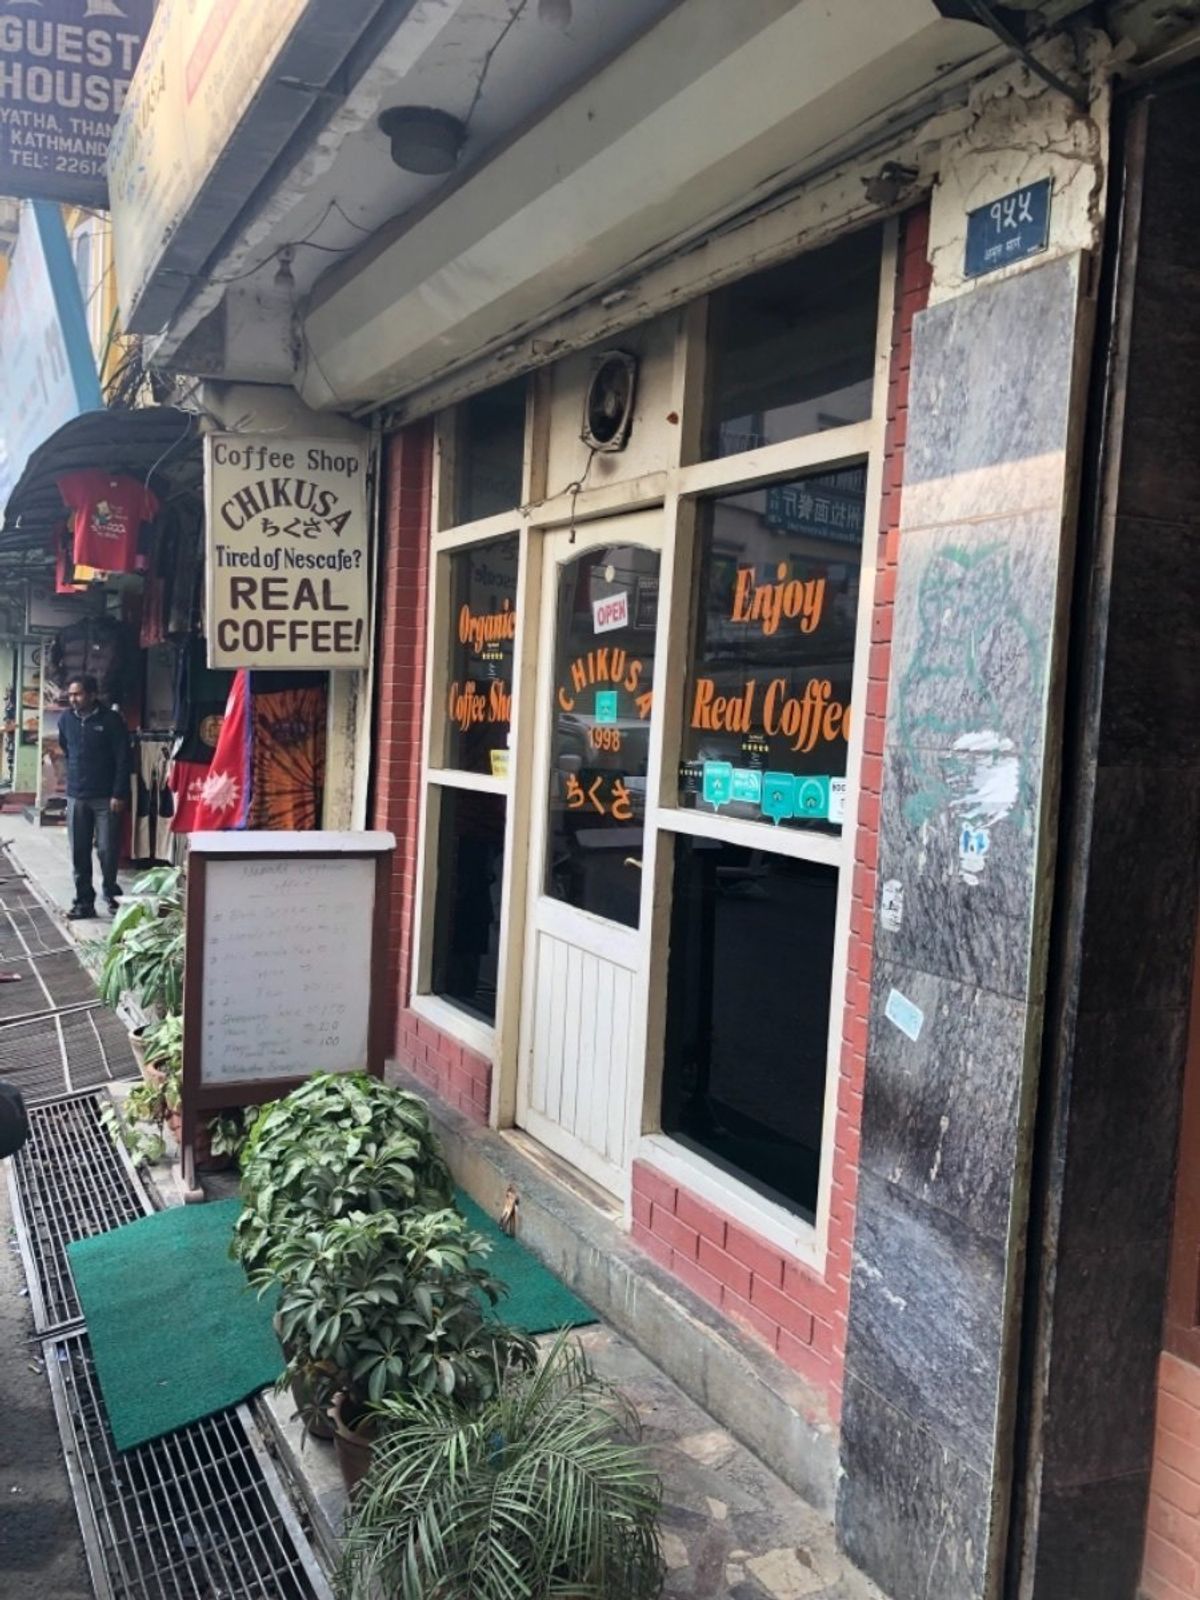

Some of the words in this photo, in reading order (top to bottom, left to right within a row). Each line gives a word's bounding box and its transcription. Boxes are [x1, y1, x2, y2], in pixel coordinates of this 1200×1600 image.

[0, 14, 140, 71] GUEST
[9, 149, 49, 169] TEL:
[214, 443, 295, 471] Coffee
[308, 449, 359, 477] Shop
[220, 477, 353, 537] CHIKUSA
[261, 517, 323, 539] ちくさ
[216, 545, 260, 567] Tired
[264, 549, 282, 571] of
[284, 548, 362, 572] Nescafe?
[230, 576, 349, 611] REAL
[730, 562, 826, 635] Enjoy
[597, 598, 626, 626] OPEN
[217, 618, 364, 652] COFFEE!
[559, 647, 654, 719] CHIKUSA
[449, 681, 486, 732] Coffee
[691, 678, 756, 733] Real
[588, 727, 621, 752] 1998
[566, 773, 634, 820] ちくさ
